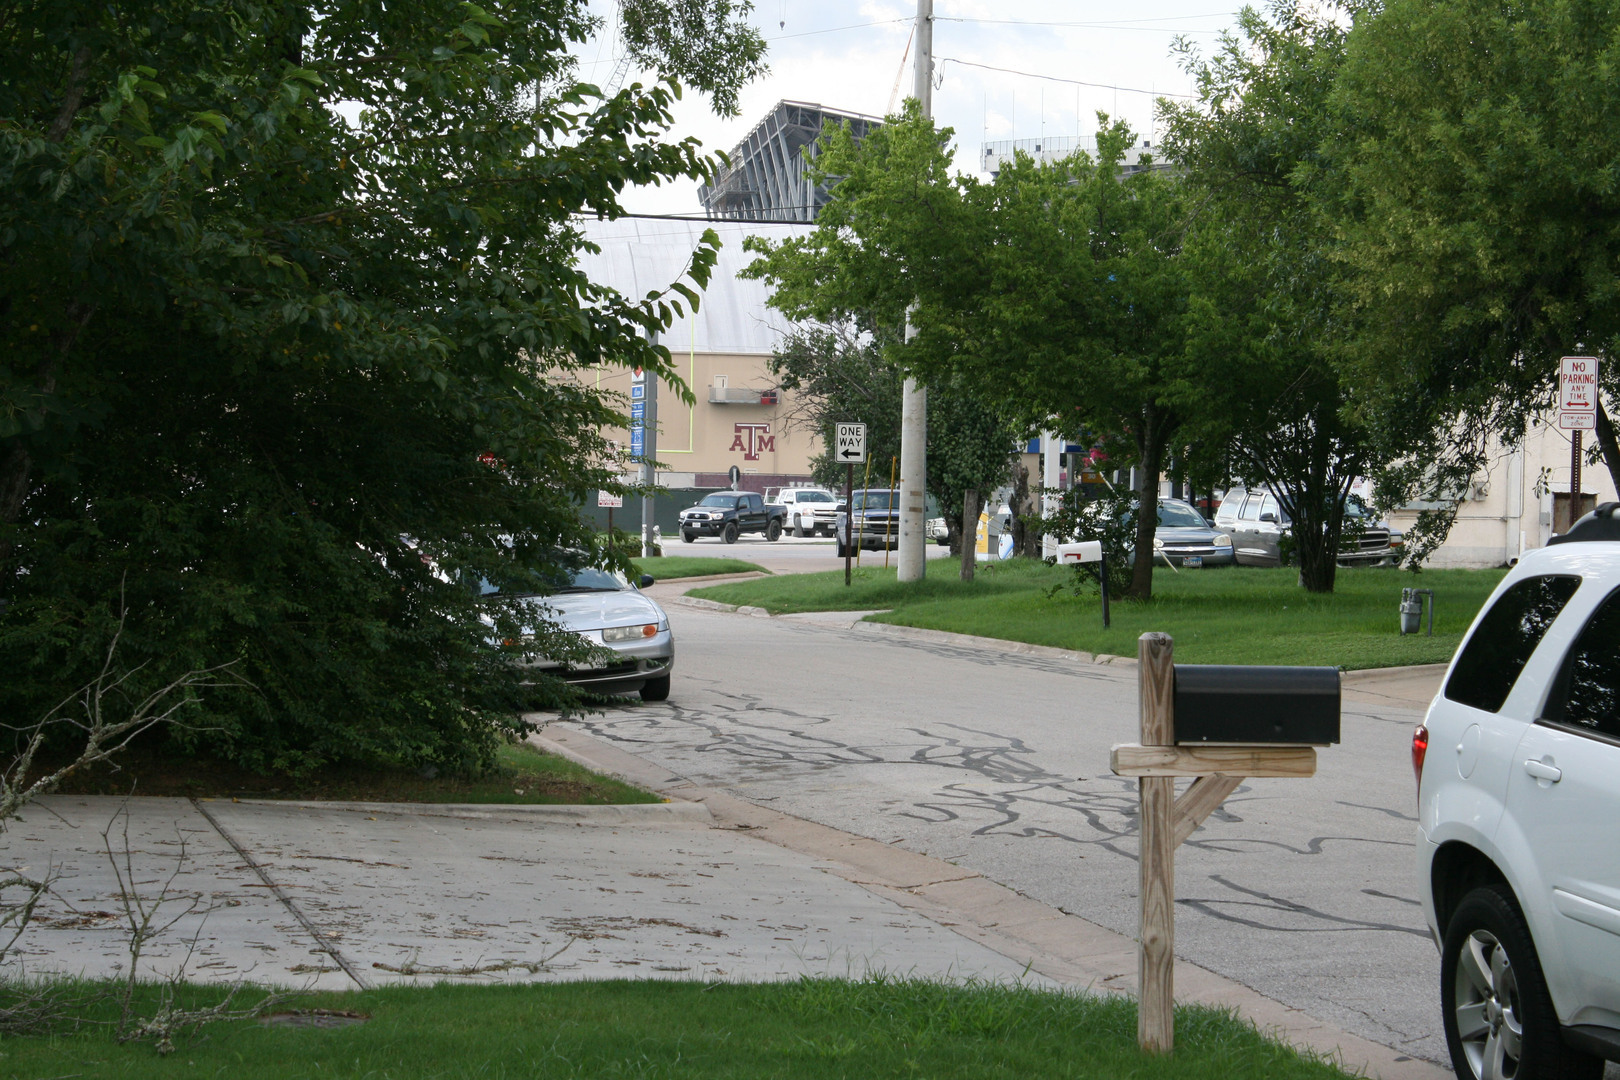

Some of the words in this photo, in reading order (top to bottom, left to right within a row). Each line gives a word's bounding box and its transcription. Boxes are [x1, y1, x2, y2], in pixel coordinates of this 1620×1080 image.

[1572, 362, 1586, 372] NO
[1563, 374, 1594, 384] PARKING
[841, 427, 861, 436] ONE
[840, 438, 862, 447] WAY
